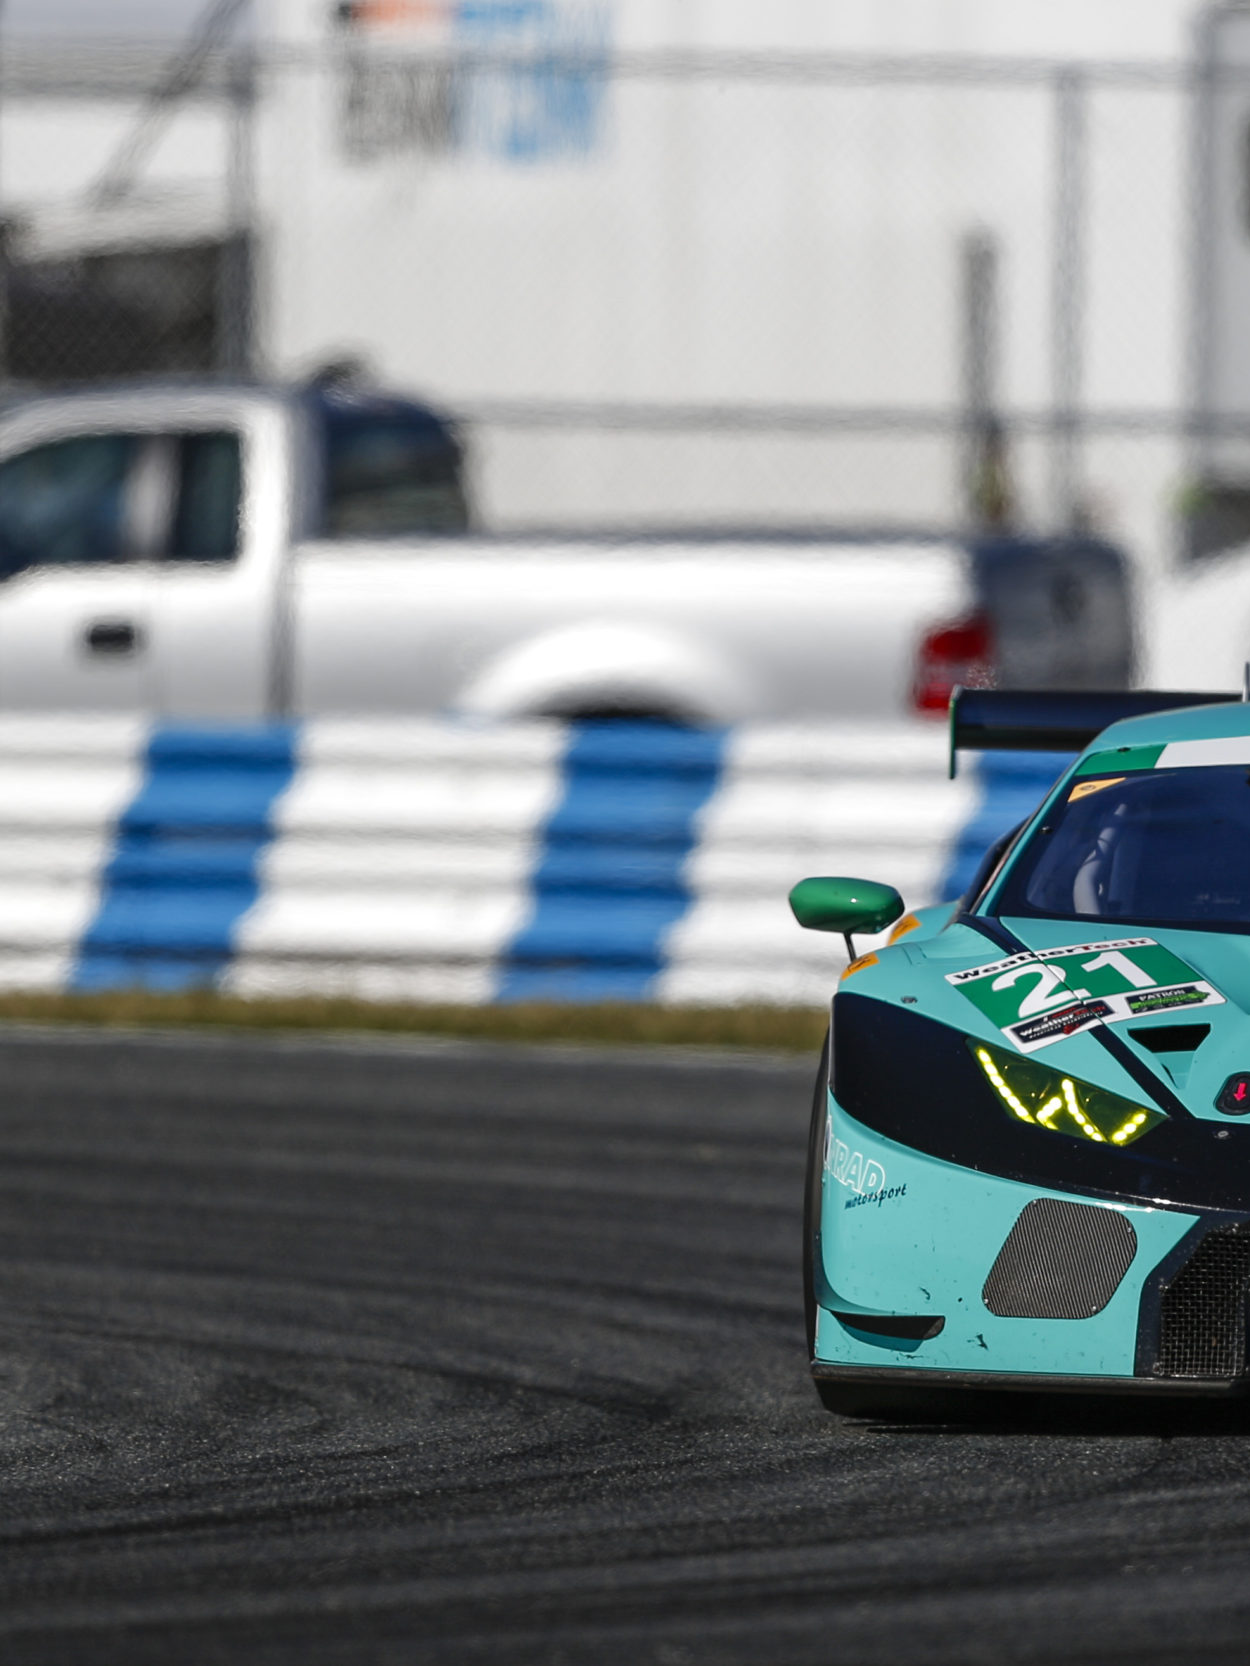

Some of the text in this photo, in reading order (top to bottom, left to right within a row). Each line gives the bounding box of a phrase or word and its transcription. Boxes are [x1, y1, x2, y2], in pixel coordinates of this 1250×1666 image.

[954, 938, 1146, 980] WeatherTech
[991, 951, 1157, 1018] 21
[844, 1183, 907, 1209] motorsport
